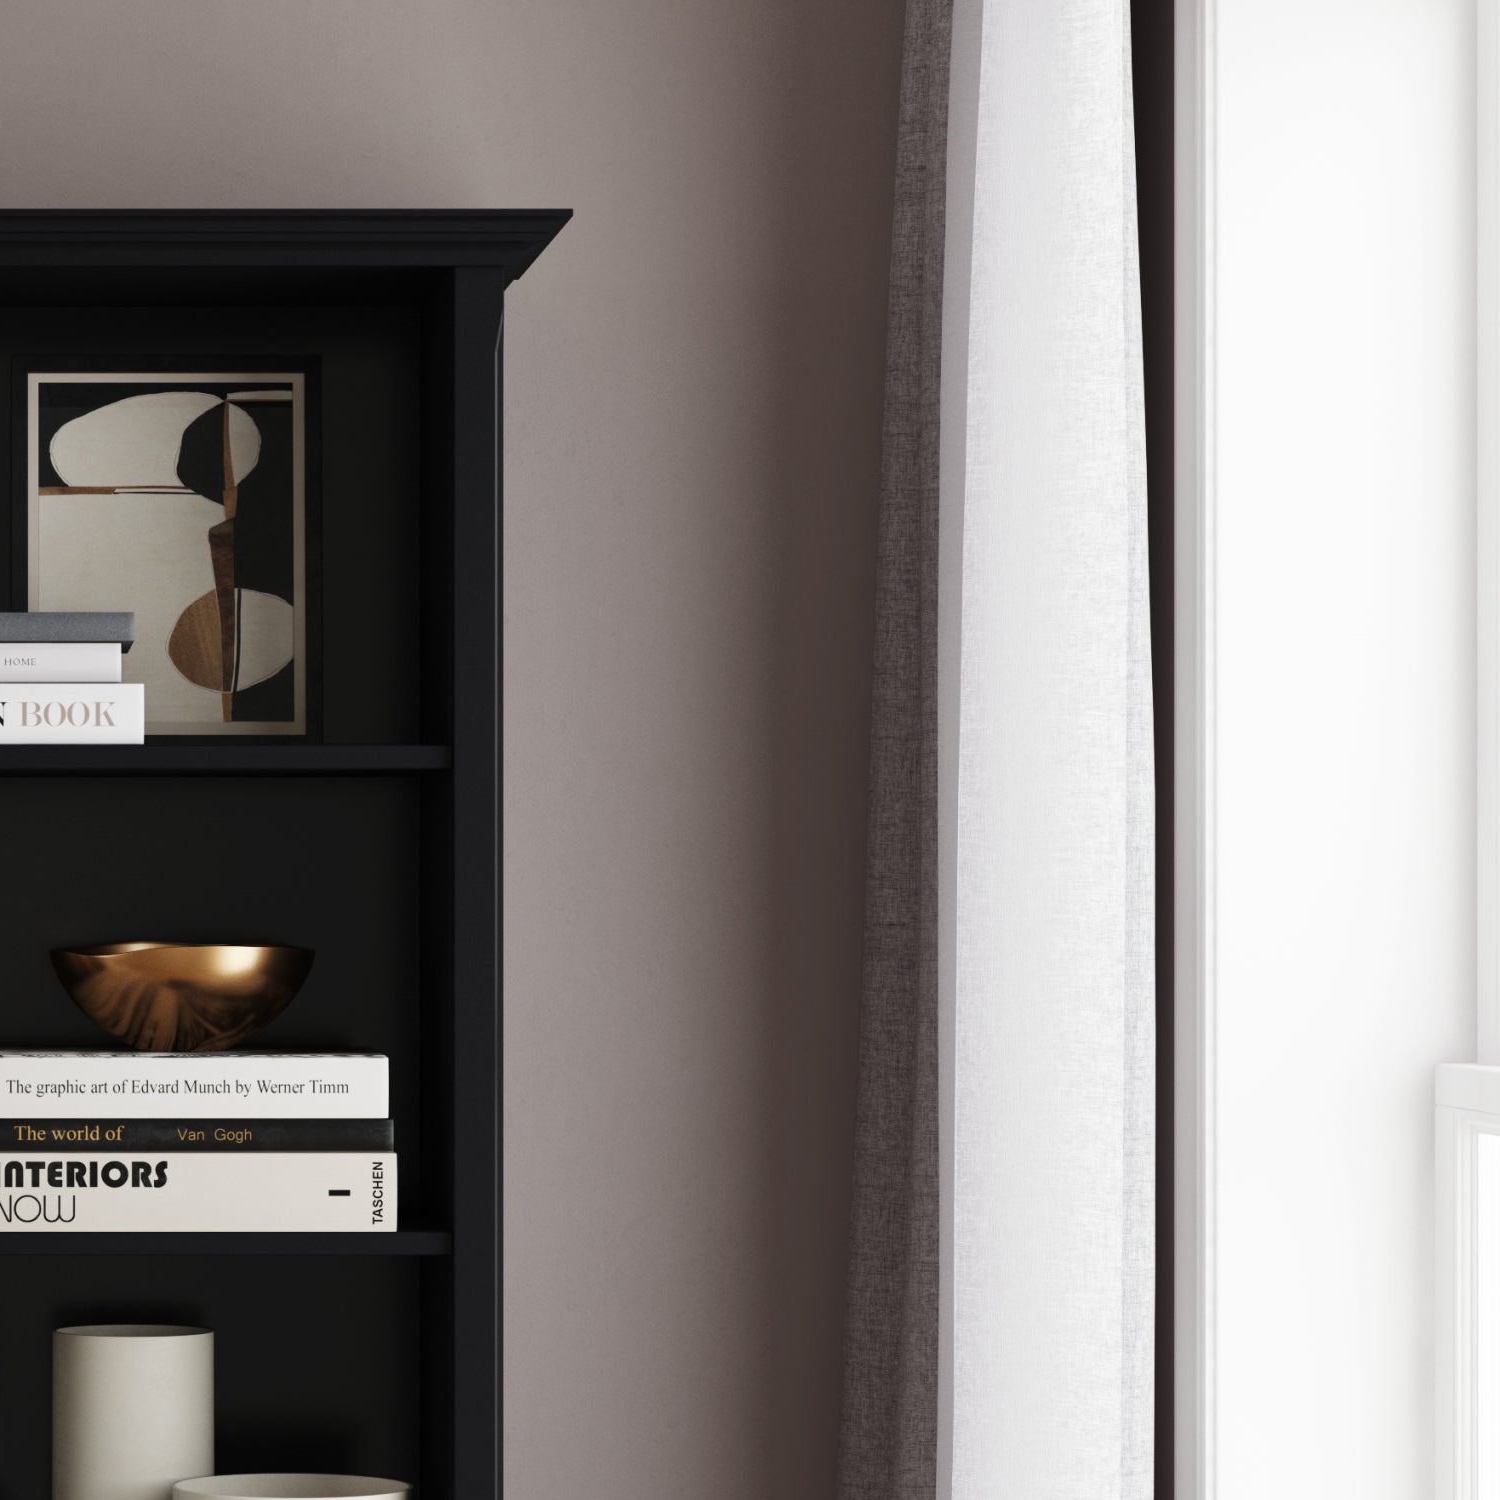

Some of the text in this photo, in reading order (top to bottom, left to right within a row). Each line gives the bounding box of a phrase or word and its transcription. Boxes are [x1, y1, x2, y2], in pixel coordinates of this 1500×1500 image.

[4, 657, 37, 667] HOME
[19, 701, 117, 727] BOOK
[5, 1079, 349, 1098] The graphic art of Edvard Munch by Werner Timm
[13, 1125, 253, 1144] The world of Van Gogh
[371, 1161, 384, 1225] TASCHEN
